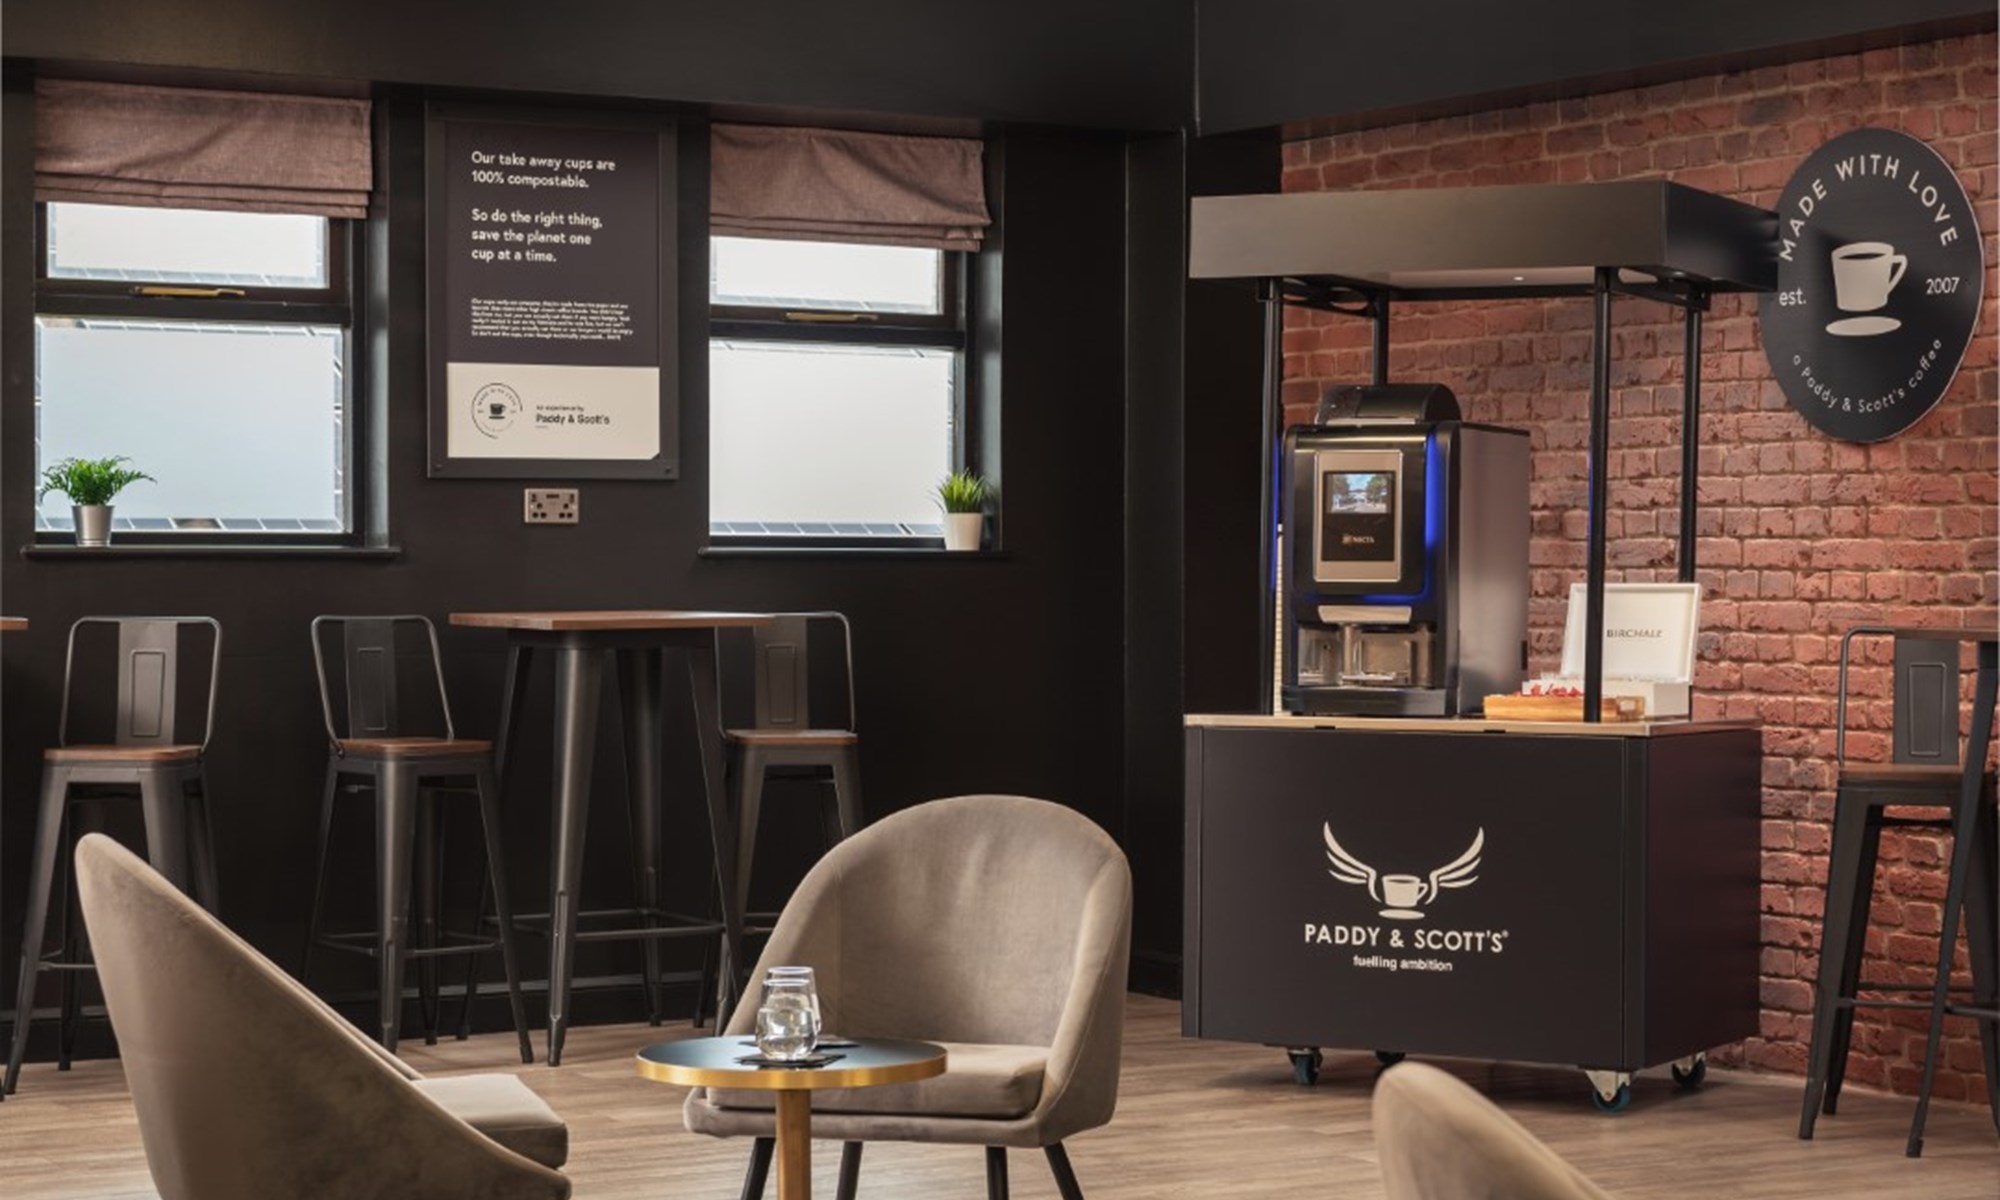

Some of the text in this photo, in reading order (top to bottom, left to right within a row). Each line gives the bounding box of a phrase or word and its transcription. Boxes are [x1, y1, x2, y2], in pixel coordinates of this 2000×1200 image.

[471, 151, 616, 171] Our take away cups are
[471, 170, 589, 189] 100% compostable.
[1779, 154, 1958, 262] MADE WITH LOVE
[471, 208, 603, 230] So do the right thing,
[471, 229, 592, 246] save the planet one
[471, 249, 557, 263] cup at a time.
[1925, 277, 1960, 295] 2007
[1779, 288, 1807, 306] est.
[1793, 339, 1942, 413] a Paddy & Scott's coffee
[536, 413, 610, 426] Paddy & Scott's
[1304, 923, 1381, 947] PADDY
[1389, 928, 1405, 948] &
[1353, 955, 1453, 972] fuelling ambition
